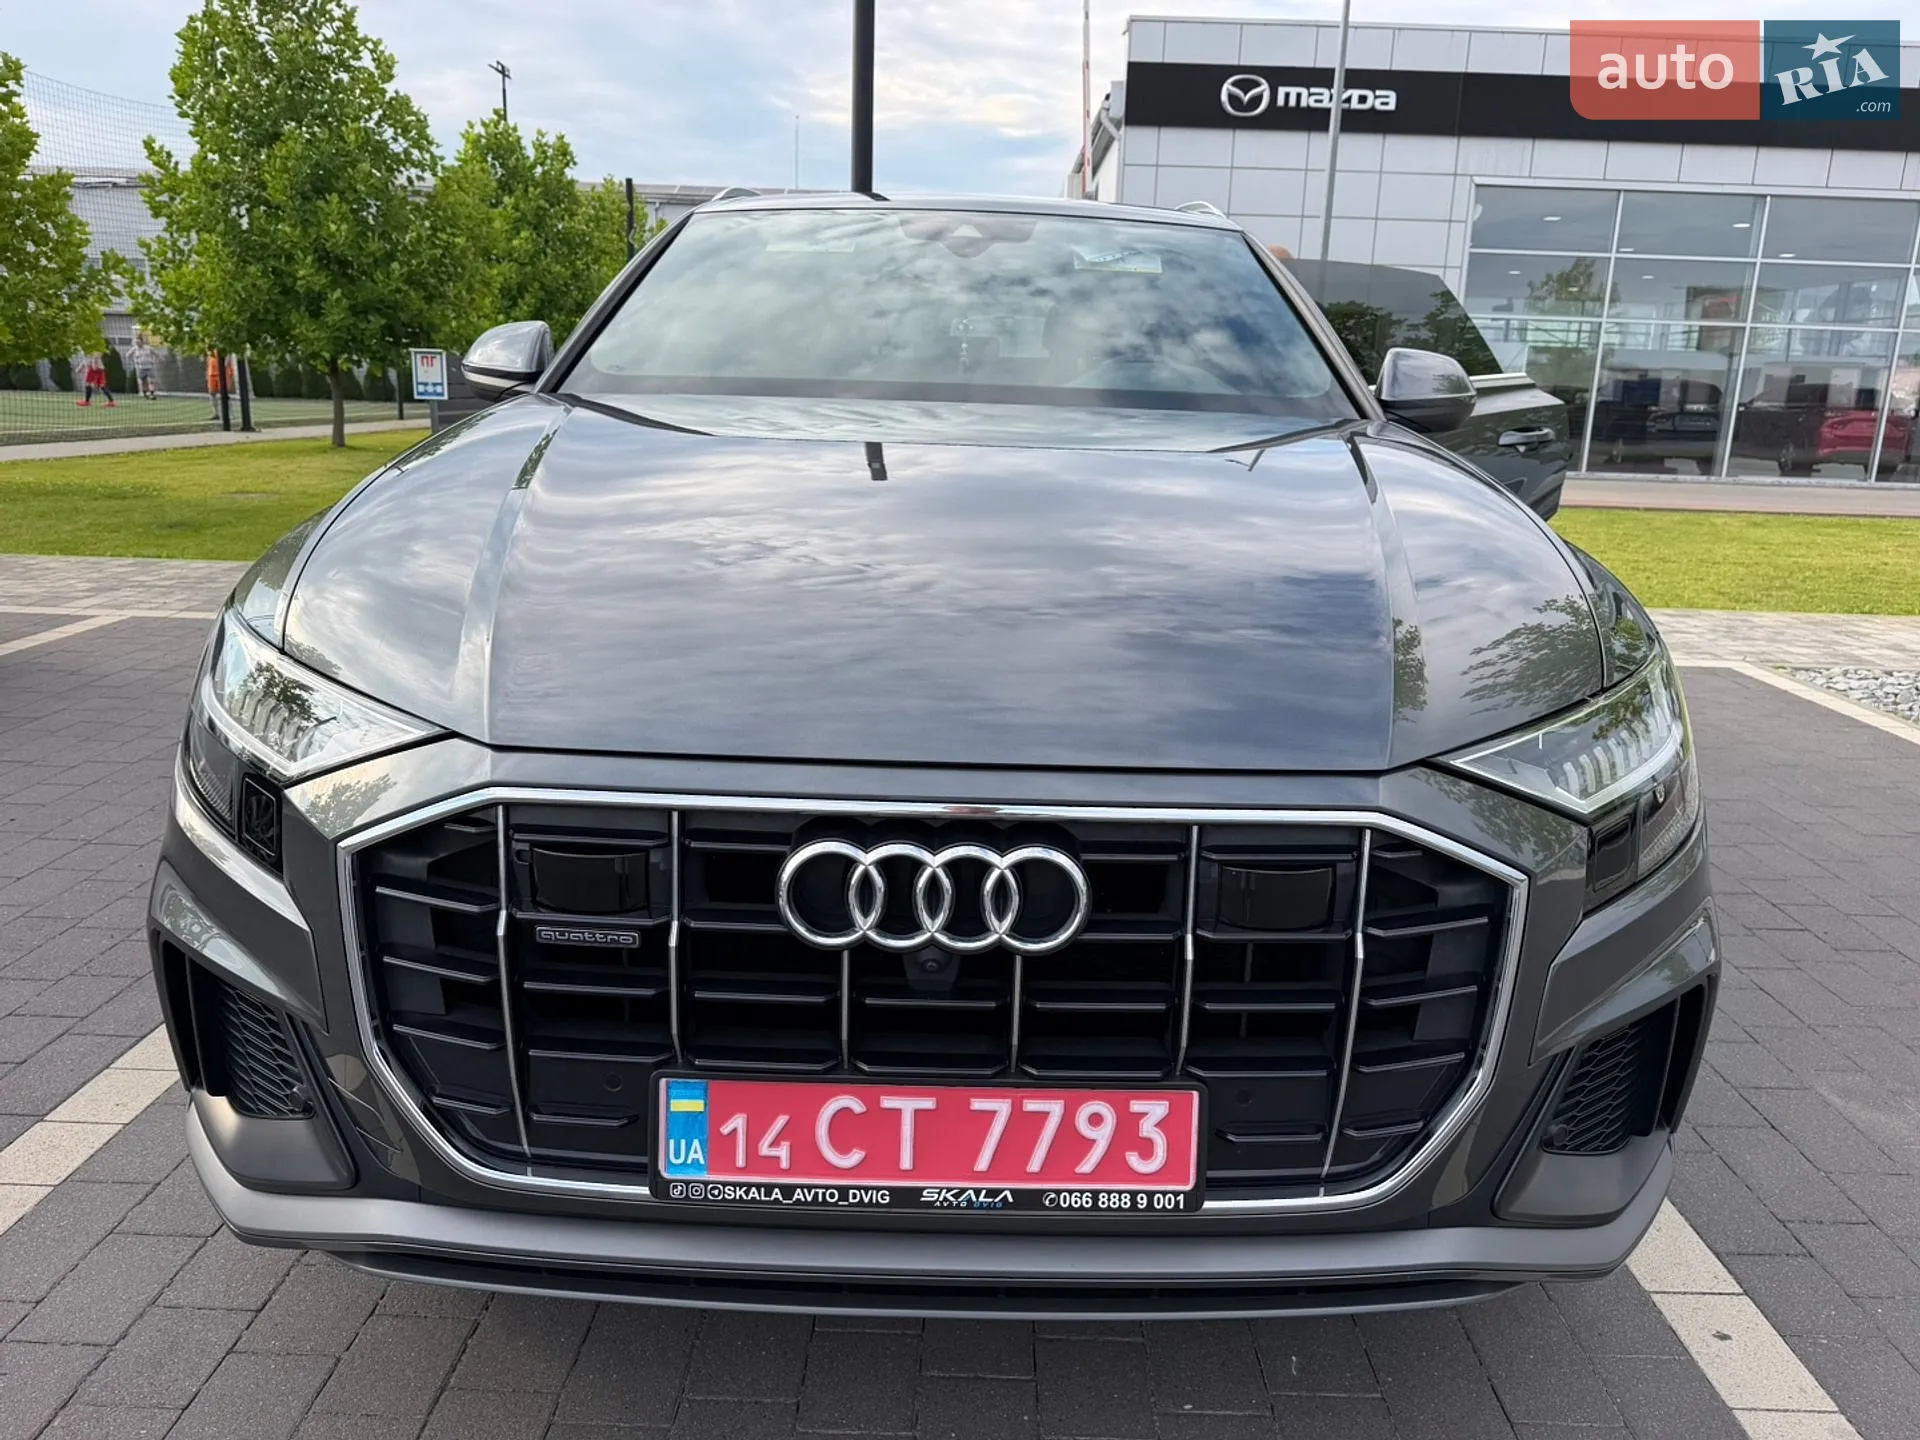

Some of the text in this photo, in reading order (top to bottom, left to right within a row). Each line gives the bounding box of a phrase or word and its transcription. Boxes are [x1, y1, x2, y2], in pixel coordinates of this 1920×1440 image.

[540, 930, 633, 944] quattro
[719, 1095, 1170, 1174] 14 CT 7793
[669, 1138, 704, 1165] UA
[724, 1186, 890, 1205] SKALA_AVTO_DVIG
[920, 1188, 1014, 1203] SKALA
[1059, 1192, 1185, 1210] 066 888 9 001
